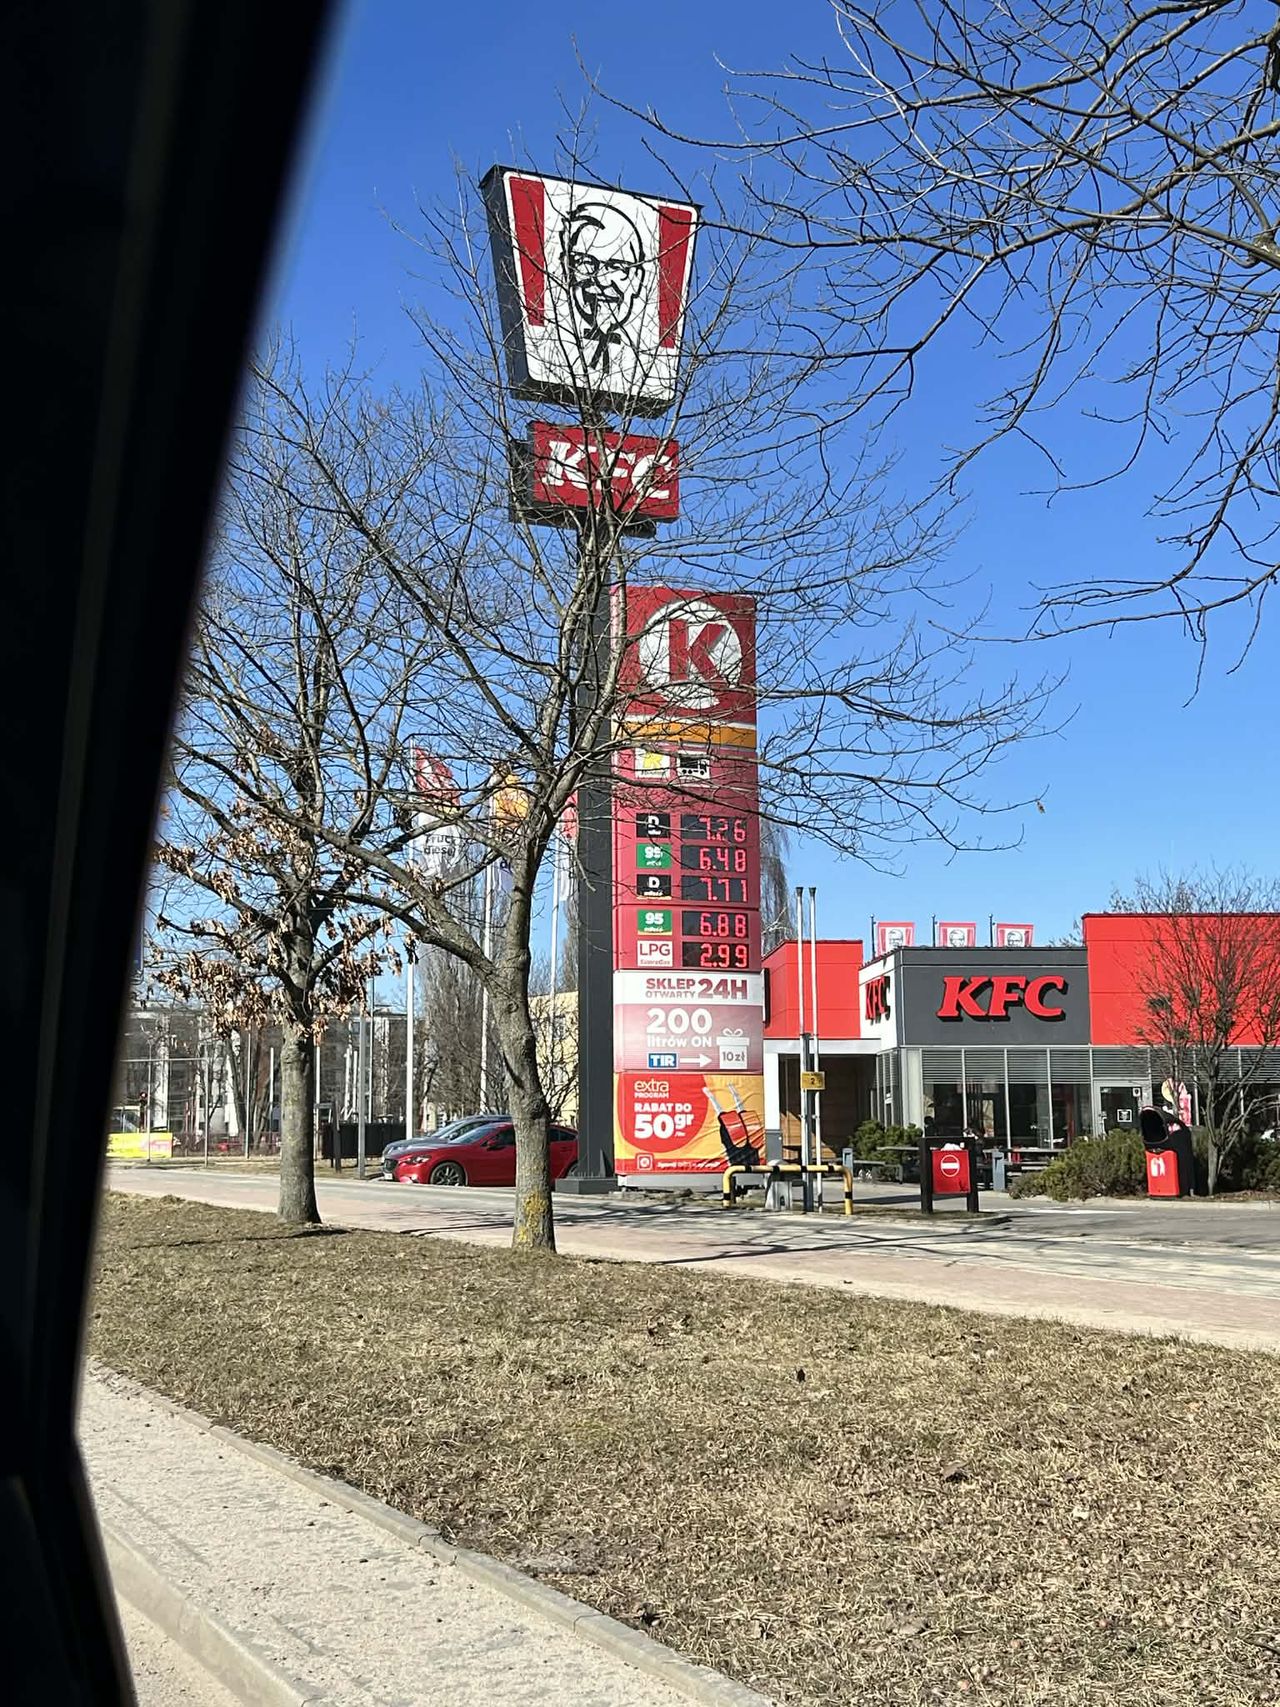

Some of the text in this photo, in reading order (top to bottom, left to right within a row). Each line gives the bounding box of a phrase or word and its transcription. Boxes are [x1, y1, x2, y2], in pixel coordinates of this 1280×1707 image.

[541, 440, 676, 500] KFC
[699, 847, 746, 873] 6.48
[648, 876, 660, 889] D
[645, 912, 747, 938] 95 6.88
[639, 943, 748, 968] LPG 2.99
[645, 990, 696, 999] OTWARTY
[646, 978, 748, 1000] SKLEP 24H
[865, 976, 886, 1020] KFC
[937, 975, 1066, 1019] KFC
[646, 1008, 712, 1035] 200
[647, 1035, 712, 1048] litrów ON
[650, 1054, 676, 1067] TIR
[634, 1079, 669, 1092] extra
[634, 1103, 692, 1113] RABAT DO
[634, 1113, 694, 1139] 50 gr
